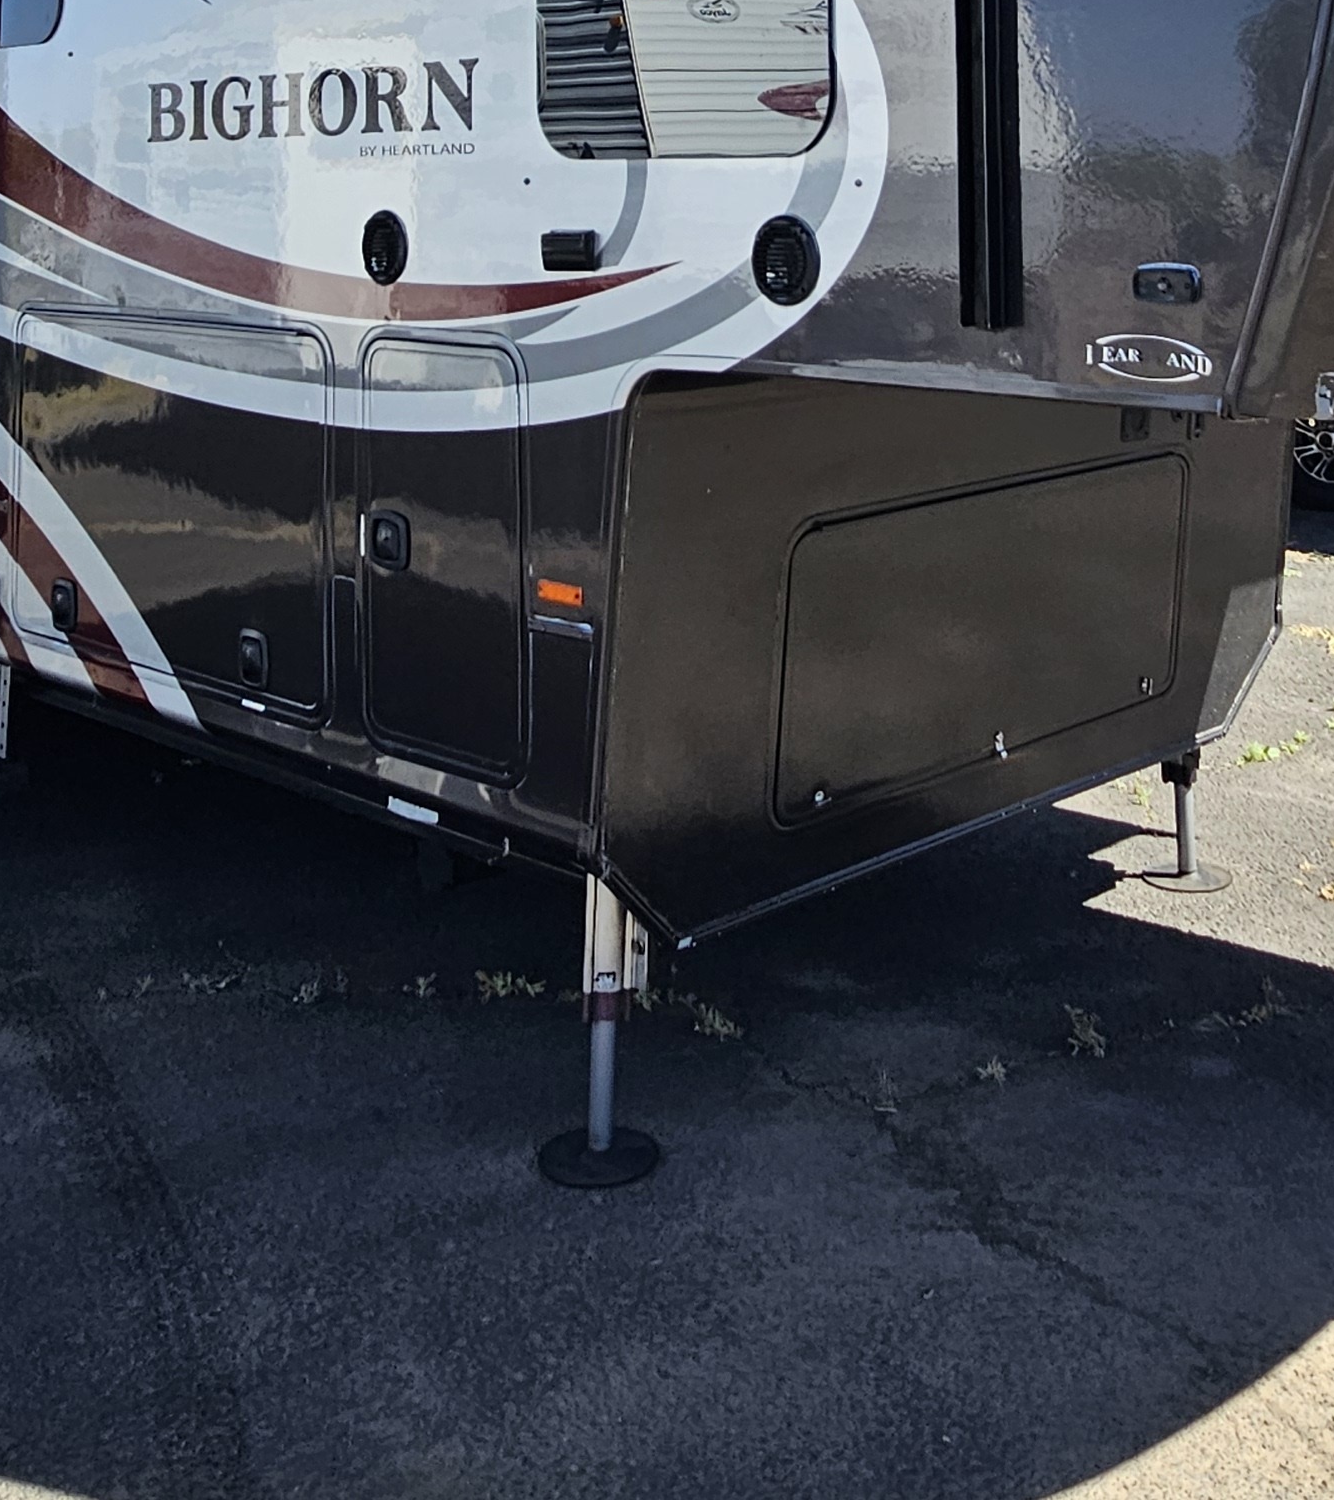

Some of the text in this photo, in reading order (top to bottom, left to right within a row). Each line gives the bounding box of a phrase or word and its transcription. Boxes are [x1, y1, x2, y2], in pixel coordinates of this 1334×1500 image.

[147, 57, 479, 143] BIGHORN
[359, 143, 475, 157] BY HEARTLAND
